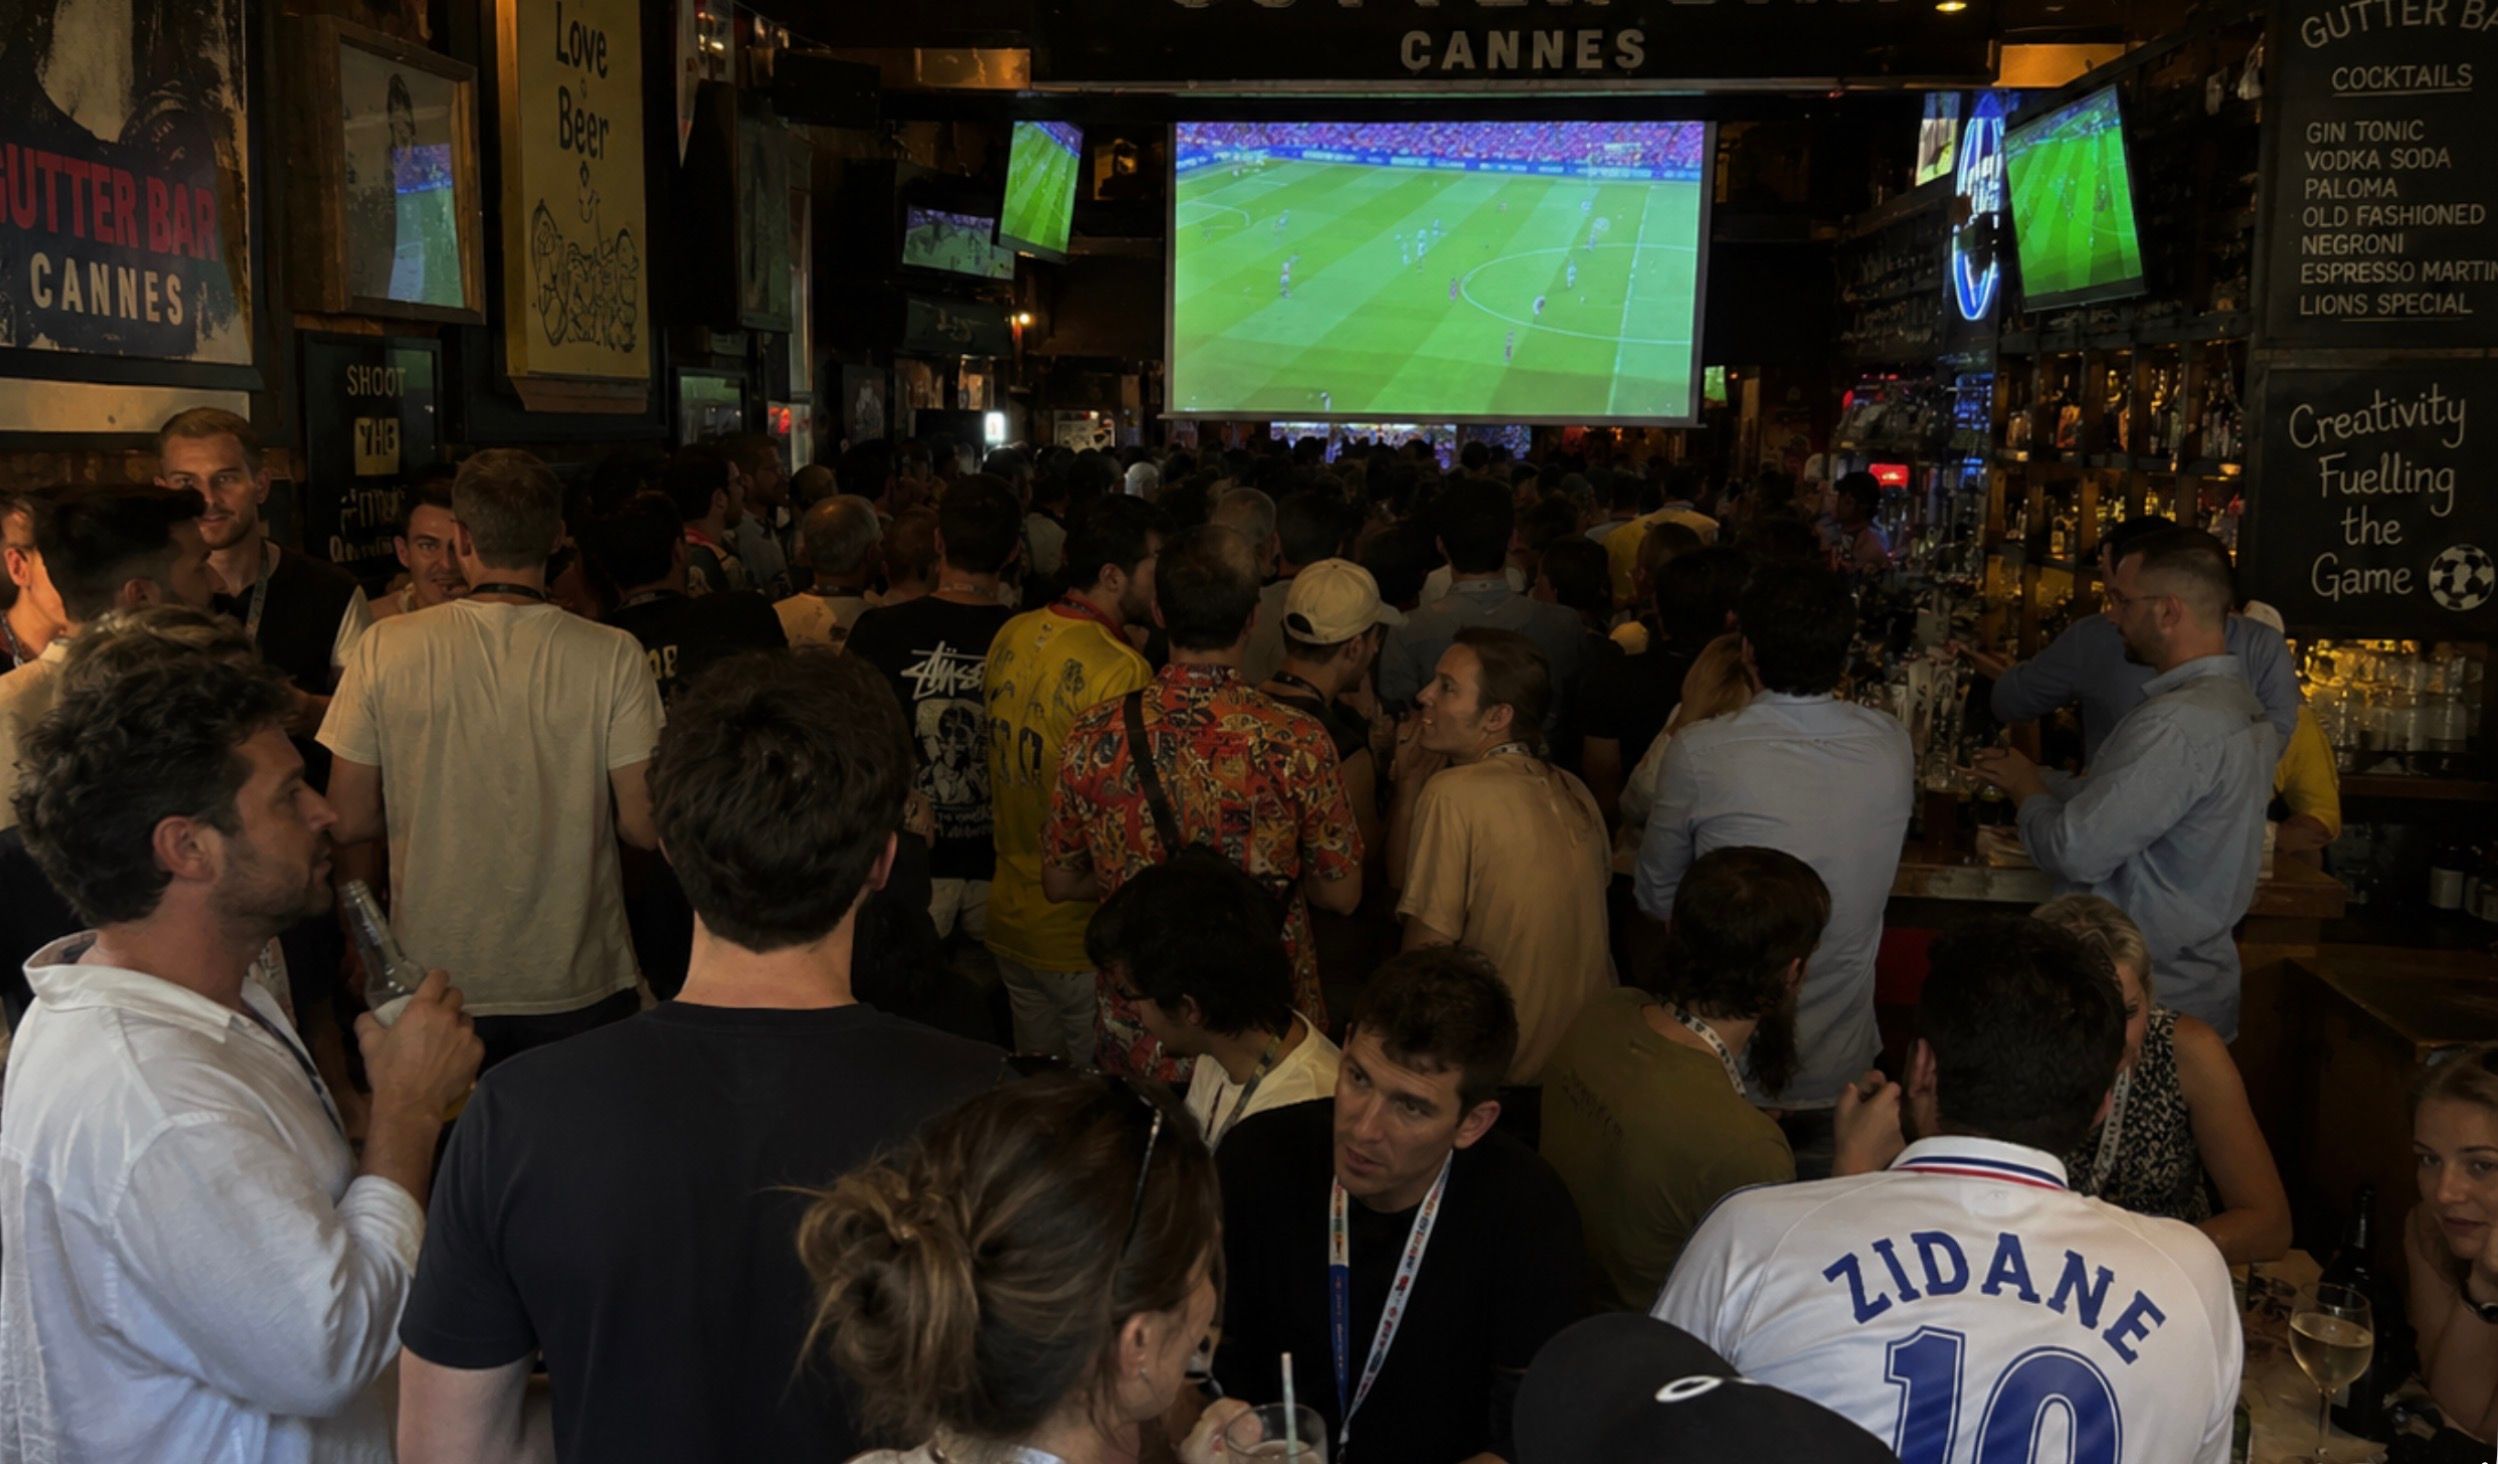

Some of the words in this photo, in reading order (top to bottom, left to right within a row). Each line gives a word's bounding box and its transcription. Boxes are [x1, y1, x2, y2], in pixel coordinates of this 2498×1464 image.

[556, 1, 608, 79] Love
[1400, 29, 1646, 71] CANNES
[2331, 63, 2474, 91] COCKTAILS
[558, 85, 609, 160] Beer
[2306, 121, 2347, 144] GIN
[2354, 118, 2425, 142] TONIC
[2304, 149, 2381, 172] VODKA
[2390, 146, 2452, 170] SODA
[2304, 176, 2399, 200] PALOMA
[146, 175, 219, 261] BAR
[2302, 205, 2349, 228] OLD
[2356, 203, 2487, 227] FASHIONED
[2301, 233, 2405, 256] NEGRONI
[30, 252, 184, 326] CANNES
[2300, 261, 2416, 285] ESPRESSO
[2299, 293, 2368, 316] LIONS
[2377, 292, 2474, 316] SPECIAL
[346, 364, 406, 397] SHOOT
[2289, 382, 2466, 449] Creativity
[2318, 451, 2455, 518] Fuelling
[2340, 504, 2404, 546] the
[2310, 551, 2414, 602] Game
[1822, 1231, 2166, 1365] ZIDANE
